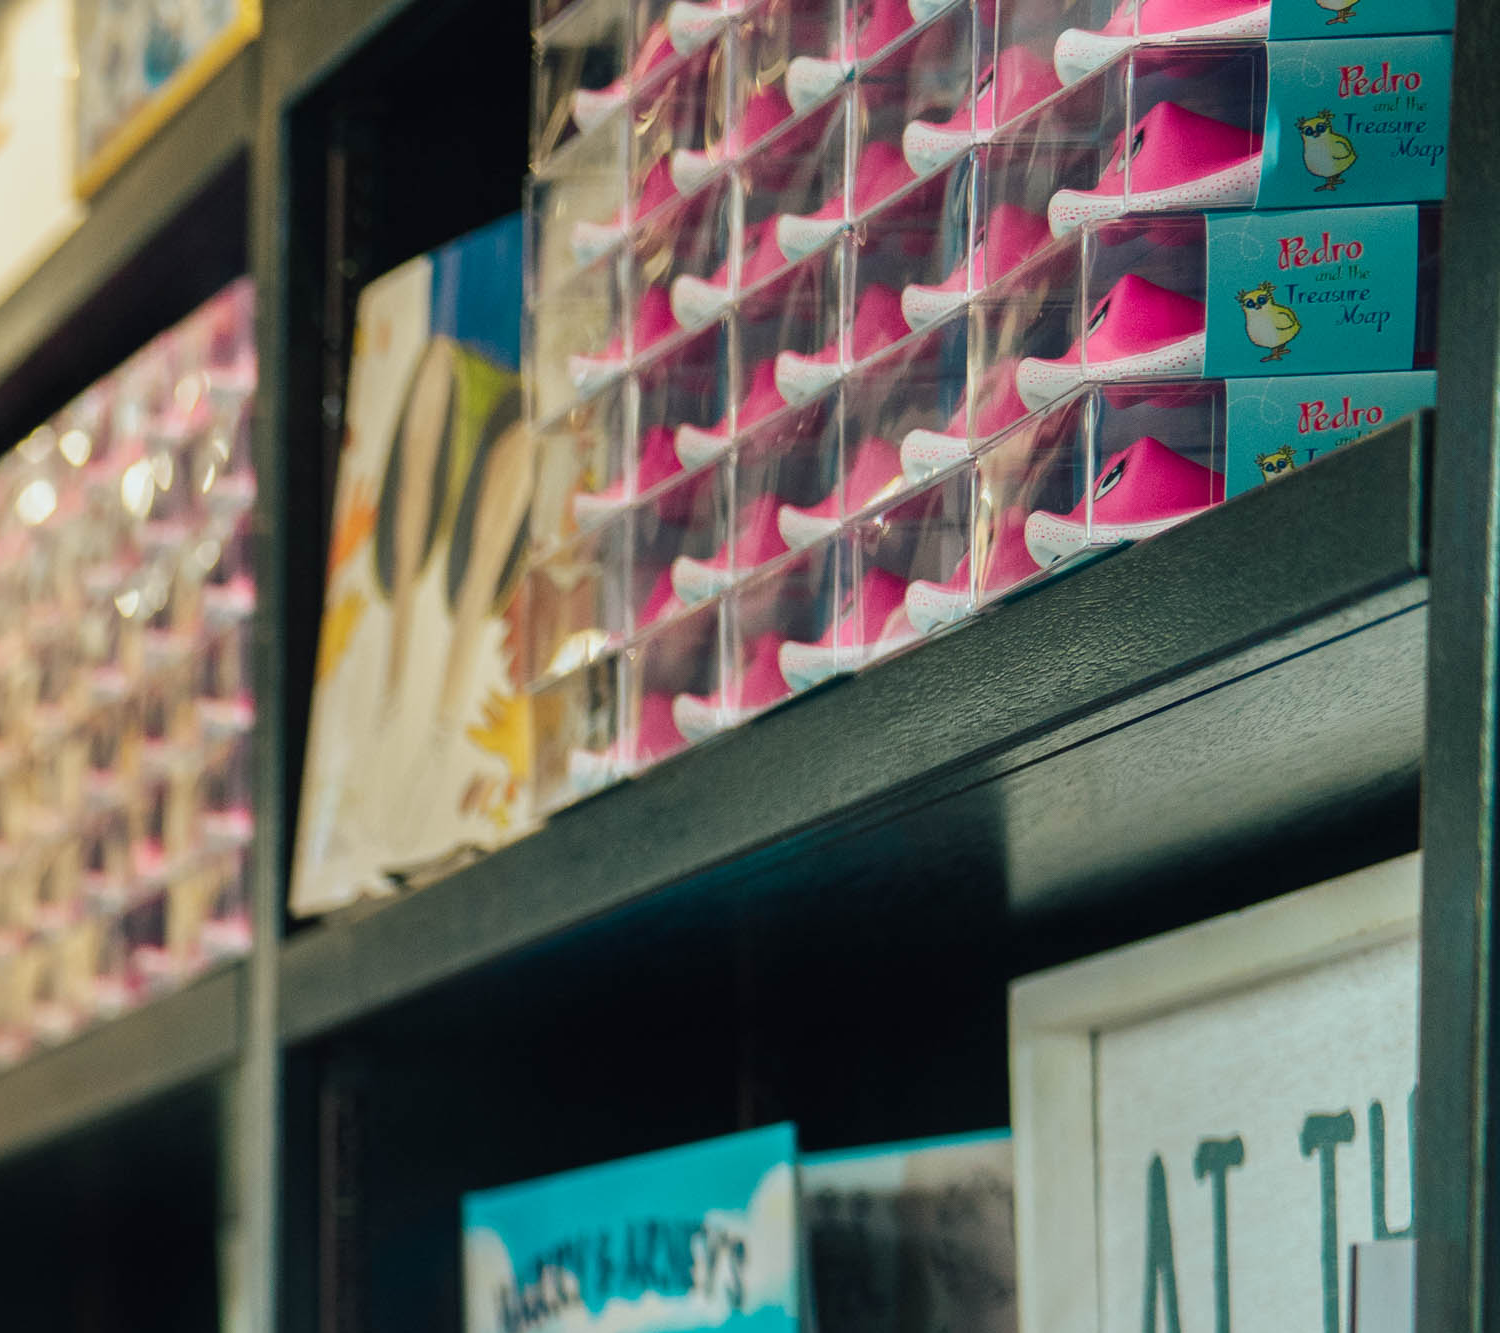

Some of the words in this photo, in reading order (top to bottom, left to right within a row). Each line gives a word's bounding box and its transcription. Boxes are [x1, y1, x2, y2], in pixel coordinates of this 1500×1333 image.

[1338, 62, 1421, 98] Pedro
[1373, 96, 1400, 112] and
[1406, 95, 1428, 111] the
[1343, 112, 1428, 136] Treasure
[1390, 137, 1445, 167] Map
[1278, 233, 1363, 270] Pedro
[1315, 264, 1342, 281] and
[1348, 264, 1370, 280] the
[1285, 283, 1370, 305] Treasure
[1335, 305, 1391, 332] Map
[1297, 397, 1383, 433] Pedro
